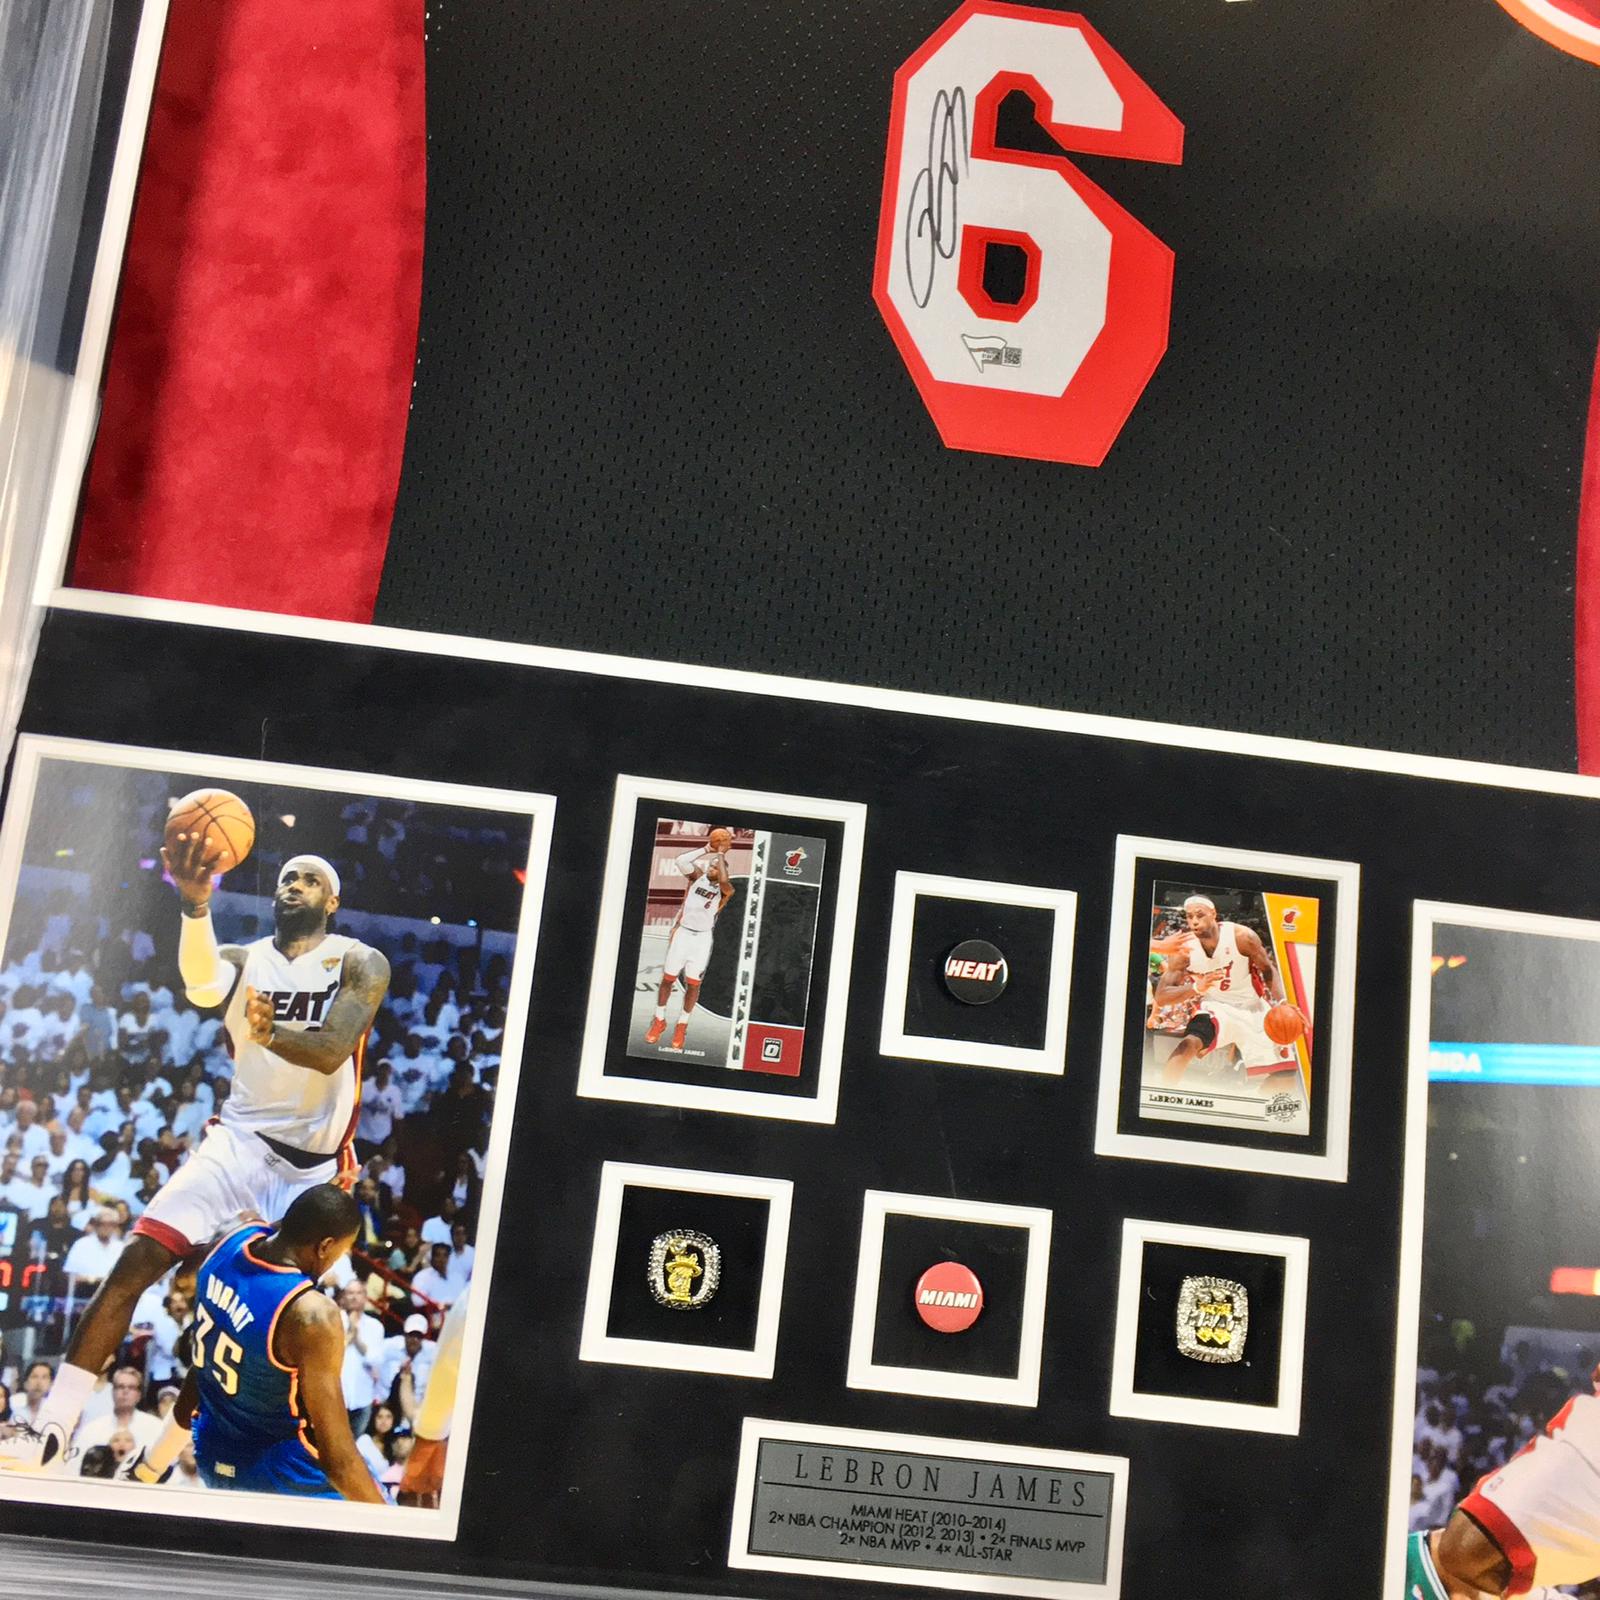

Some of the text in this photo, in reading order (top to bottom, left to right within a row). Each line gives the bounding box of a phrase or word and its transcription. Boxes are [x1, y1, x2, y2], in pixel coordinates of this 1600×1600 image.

[872, 0, 1185, 468] 6
[945, 959, 1003, 982] HEAT
[246, 980, 339, 1022] EAT
[1184, 1098, 1214, 1108] JAMES
[1267, 1104, 1299, 1114] SEASON
[919, 1289, 979, 1309] MIAMI
[192, 1301, 243, 1396] 35
[795, 1453, 1086, 1508] LEBRON JAMES
[850, 1503, 892, 1520] MIAMI
[895, 1508, 929, 1523] HEAT
[788, 1513, 816, 1528] NBA
[819, 1515, 895, 1535] CHAMPION
[940, 1527, 975, 1545] 2013)
[1009, 1534, 1051, 1551] FINALS
[1055, 1539, 1086, 1554] MVP
[859, 1535, 887, 1550] NBA
[890, 1538, 921, 1553] MVP
[954, 1545, 1013, 1562] ALL-STAR
